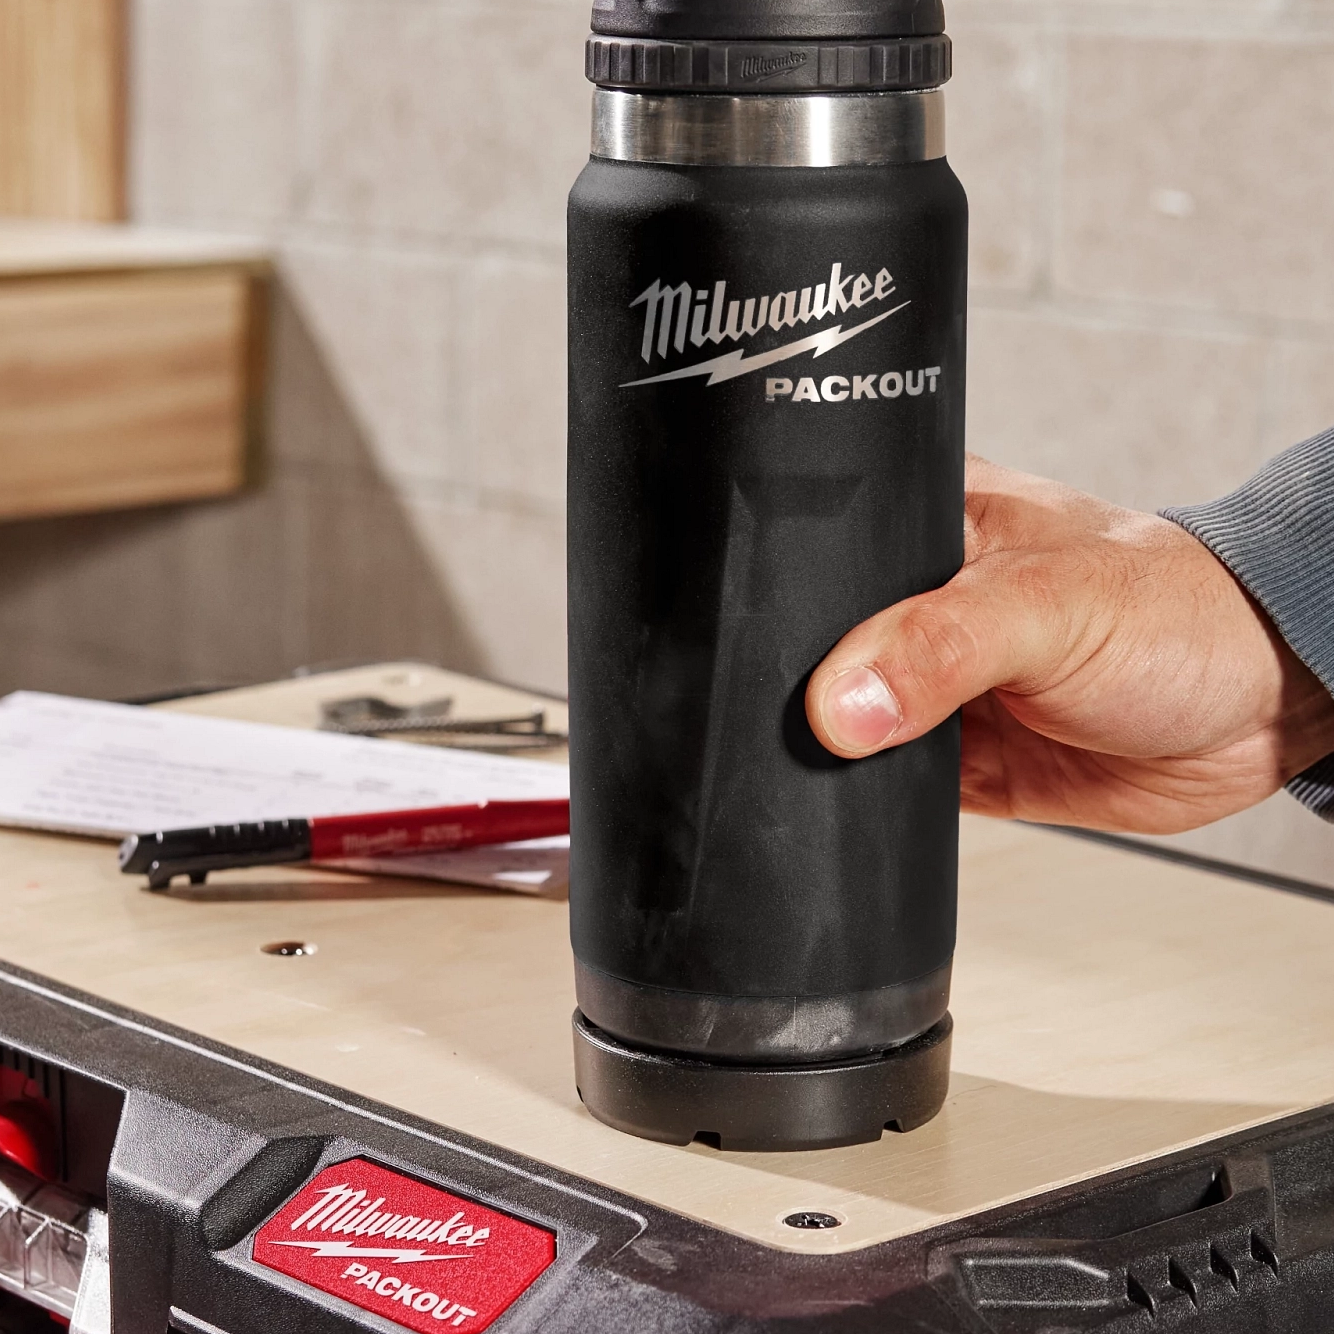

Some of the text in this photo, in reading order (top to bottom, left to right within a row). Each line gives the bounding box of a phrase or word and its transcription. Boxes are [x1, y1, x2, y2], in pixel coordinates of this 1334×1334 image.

[739, 50, 807, 78] Milwaukee
[628, 262, 898, 363] Milwaukee
[765, 365, 942, 404] PACKOUT
[290, 1183, 491, 1247] Milwaukee
[339, 1262, 477, 1327] PACKOUT
